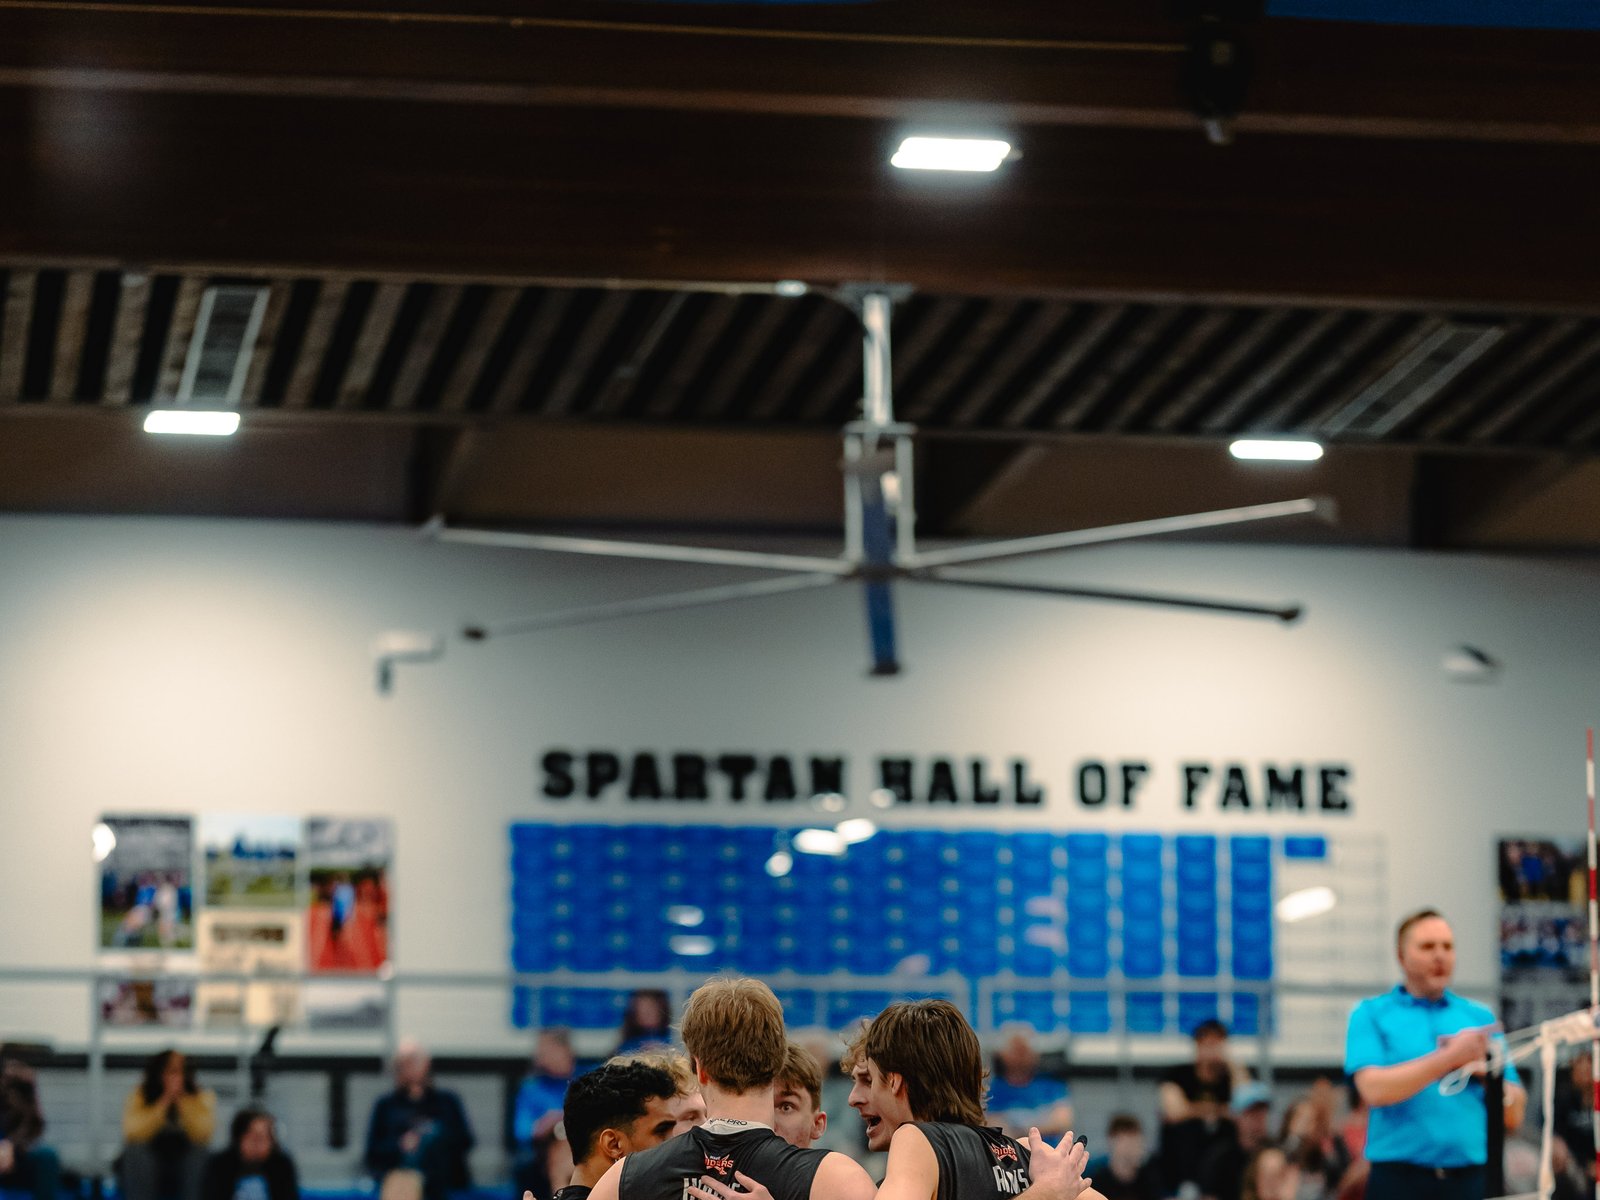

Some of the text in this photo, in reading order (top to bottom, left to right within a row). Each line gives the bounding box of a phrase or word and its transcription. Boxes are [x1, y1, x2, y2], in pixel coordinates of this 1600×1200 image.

[541, 750, 1350, 812] SPARTAN HALL OF FAME
